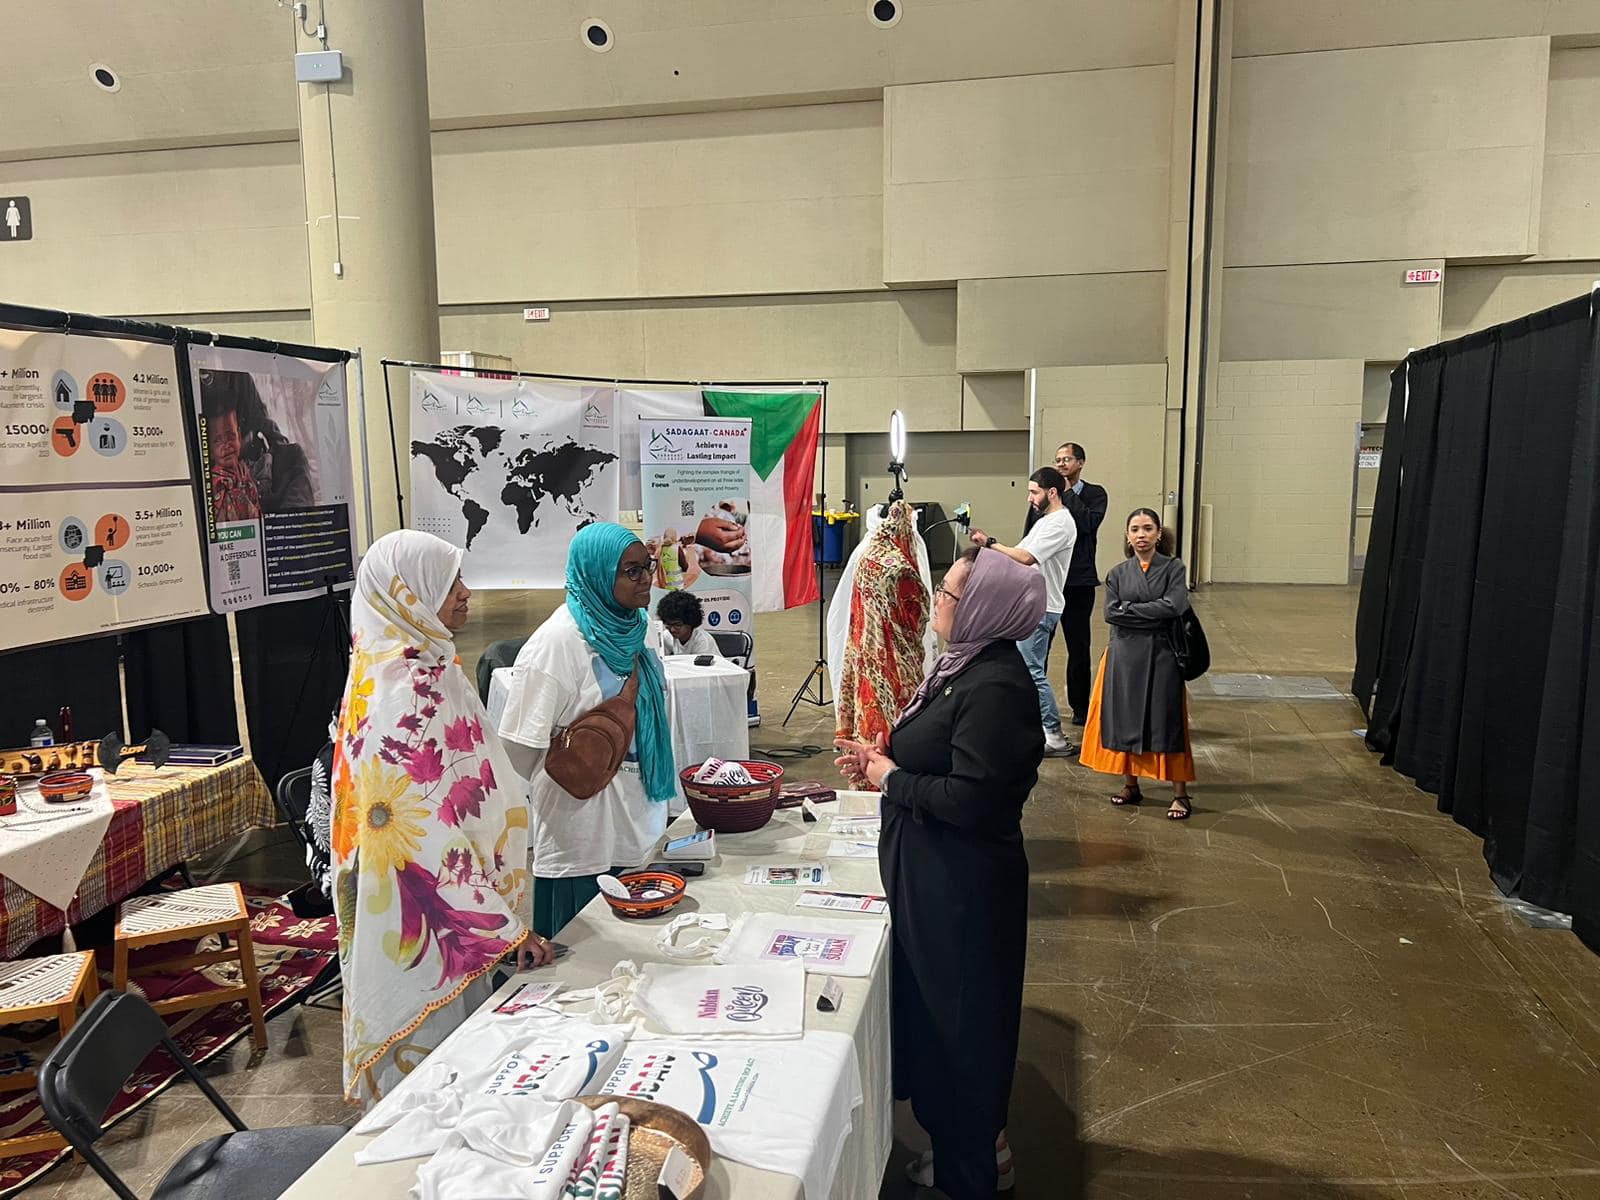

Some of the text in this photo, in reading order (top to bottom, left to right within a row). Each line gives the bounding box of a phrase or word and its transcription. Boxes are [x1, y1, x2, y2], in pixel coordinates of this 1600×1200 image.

[1416, 270, 1432, 281] EXIT
[200, 417, 210, 479] BLEEDING
[686, 453, 736, 461] Lasting Impact
[16, 518, 51, 530] Million
[207, 496, 216, 539] SUDAN
[229, 529, 242, 538] CAN
[219, 542, 234, 550] MAKE
[224, 549, 257, 561] DIFFERENCE
[138, 563, 174, 576] 10,000+
[33, 578, 55, 590] 80%
[826, 938, 849, 960] SUDAN
[697, 988, 720, 1019] Nubian
[725, 985, 768, 1022] Queen
[601, 1056, 634, 1095] UPPORT
[539, 1122, 578, 1174] SUPPORT
